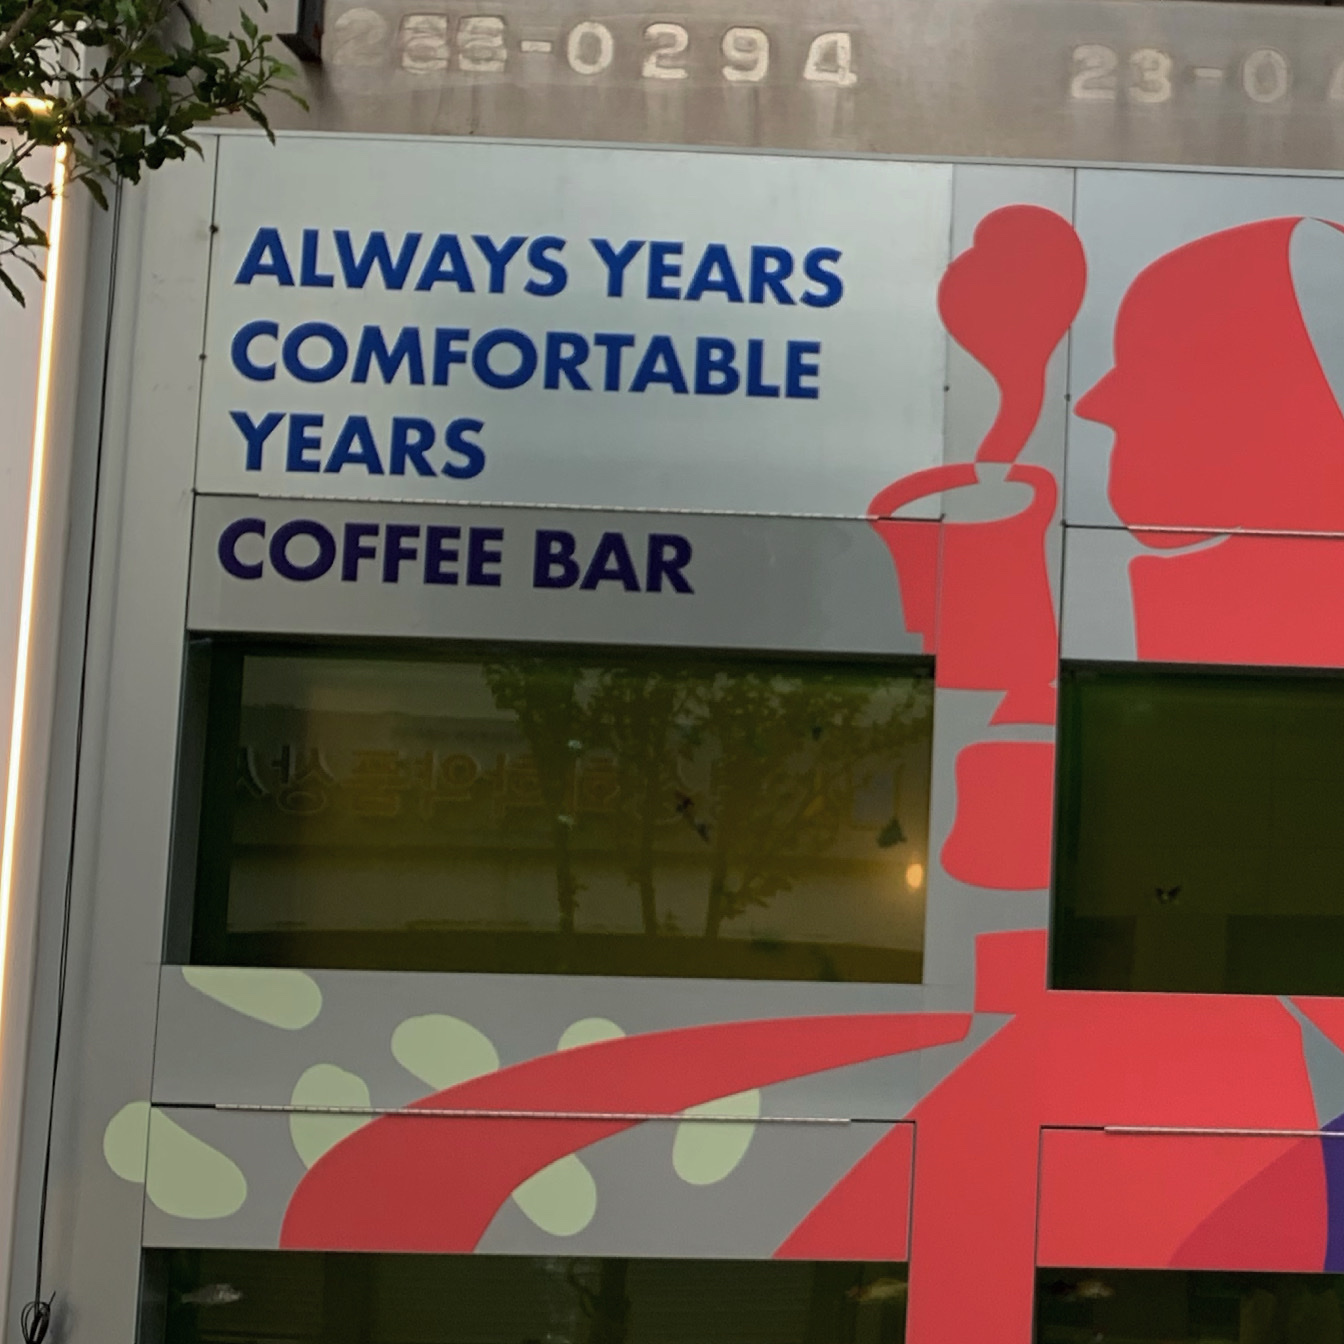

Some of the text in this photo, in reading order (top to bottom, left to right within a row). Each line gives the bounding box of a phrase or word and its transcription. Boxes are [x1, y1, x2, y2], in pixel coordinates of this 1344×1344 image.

[233, 226, 844, 309] ALWAYS YEARS
[231, 319, 821, 400] COMFORTABLE
[231, 411, 486, 480] YEARS
[218, 518, 696, 595] COFFEE BAR
